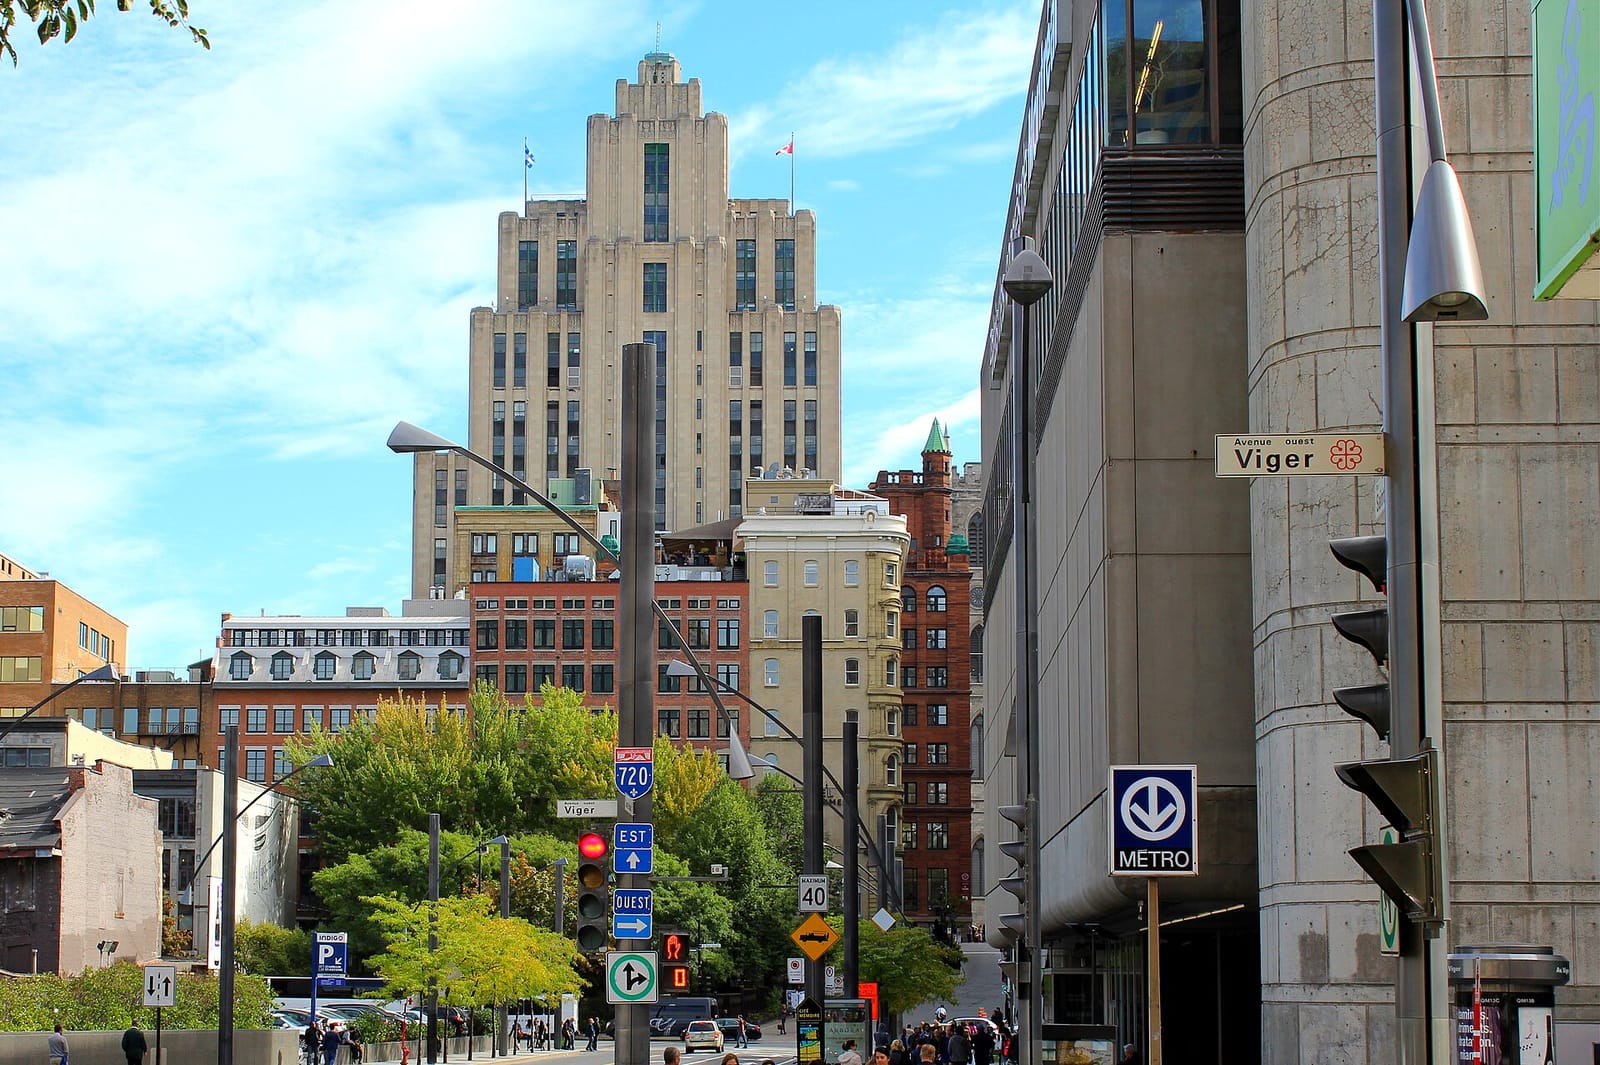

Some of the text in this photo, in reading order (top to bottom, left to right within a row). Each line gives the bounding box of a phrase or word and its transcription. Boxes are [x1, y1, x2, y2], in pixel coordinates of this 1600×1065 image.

[1234, 438, 1272, 446] Avenue
[1234, 449, 1314, 473] Viger
[618, 766, 648, 786] 720
[564, 805, 595, 816] Viger
[620, 830, 646, 843] EST
[1119, 849, 1190, 868] MÉTRO
[616, 896, 649, 909] OUEST
[802, 887, 826, 906] 40
[319, 945, 334, 964] P
[674, 968, 686, 987] 0
